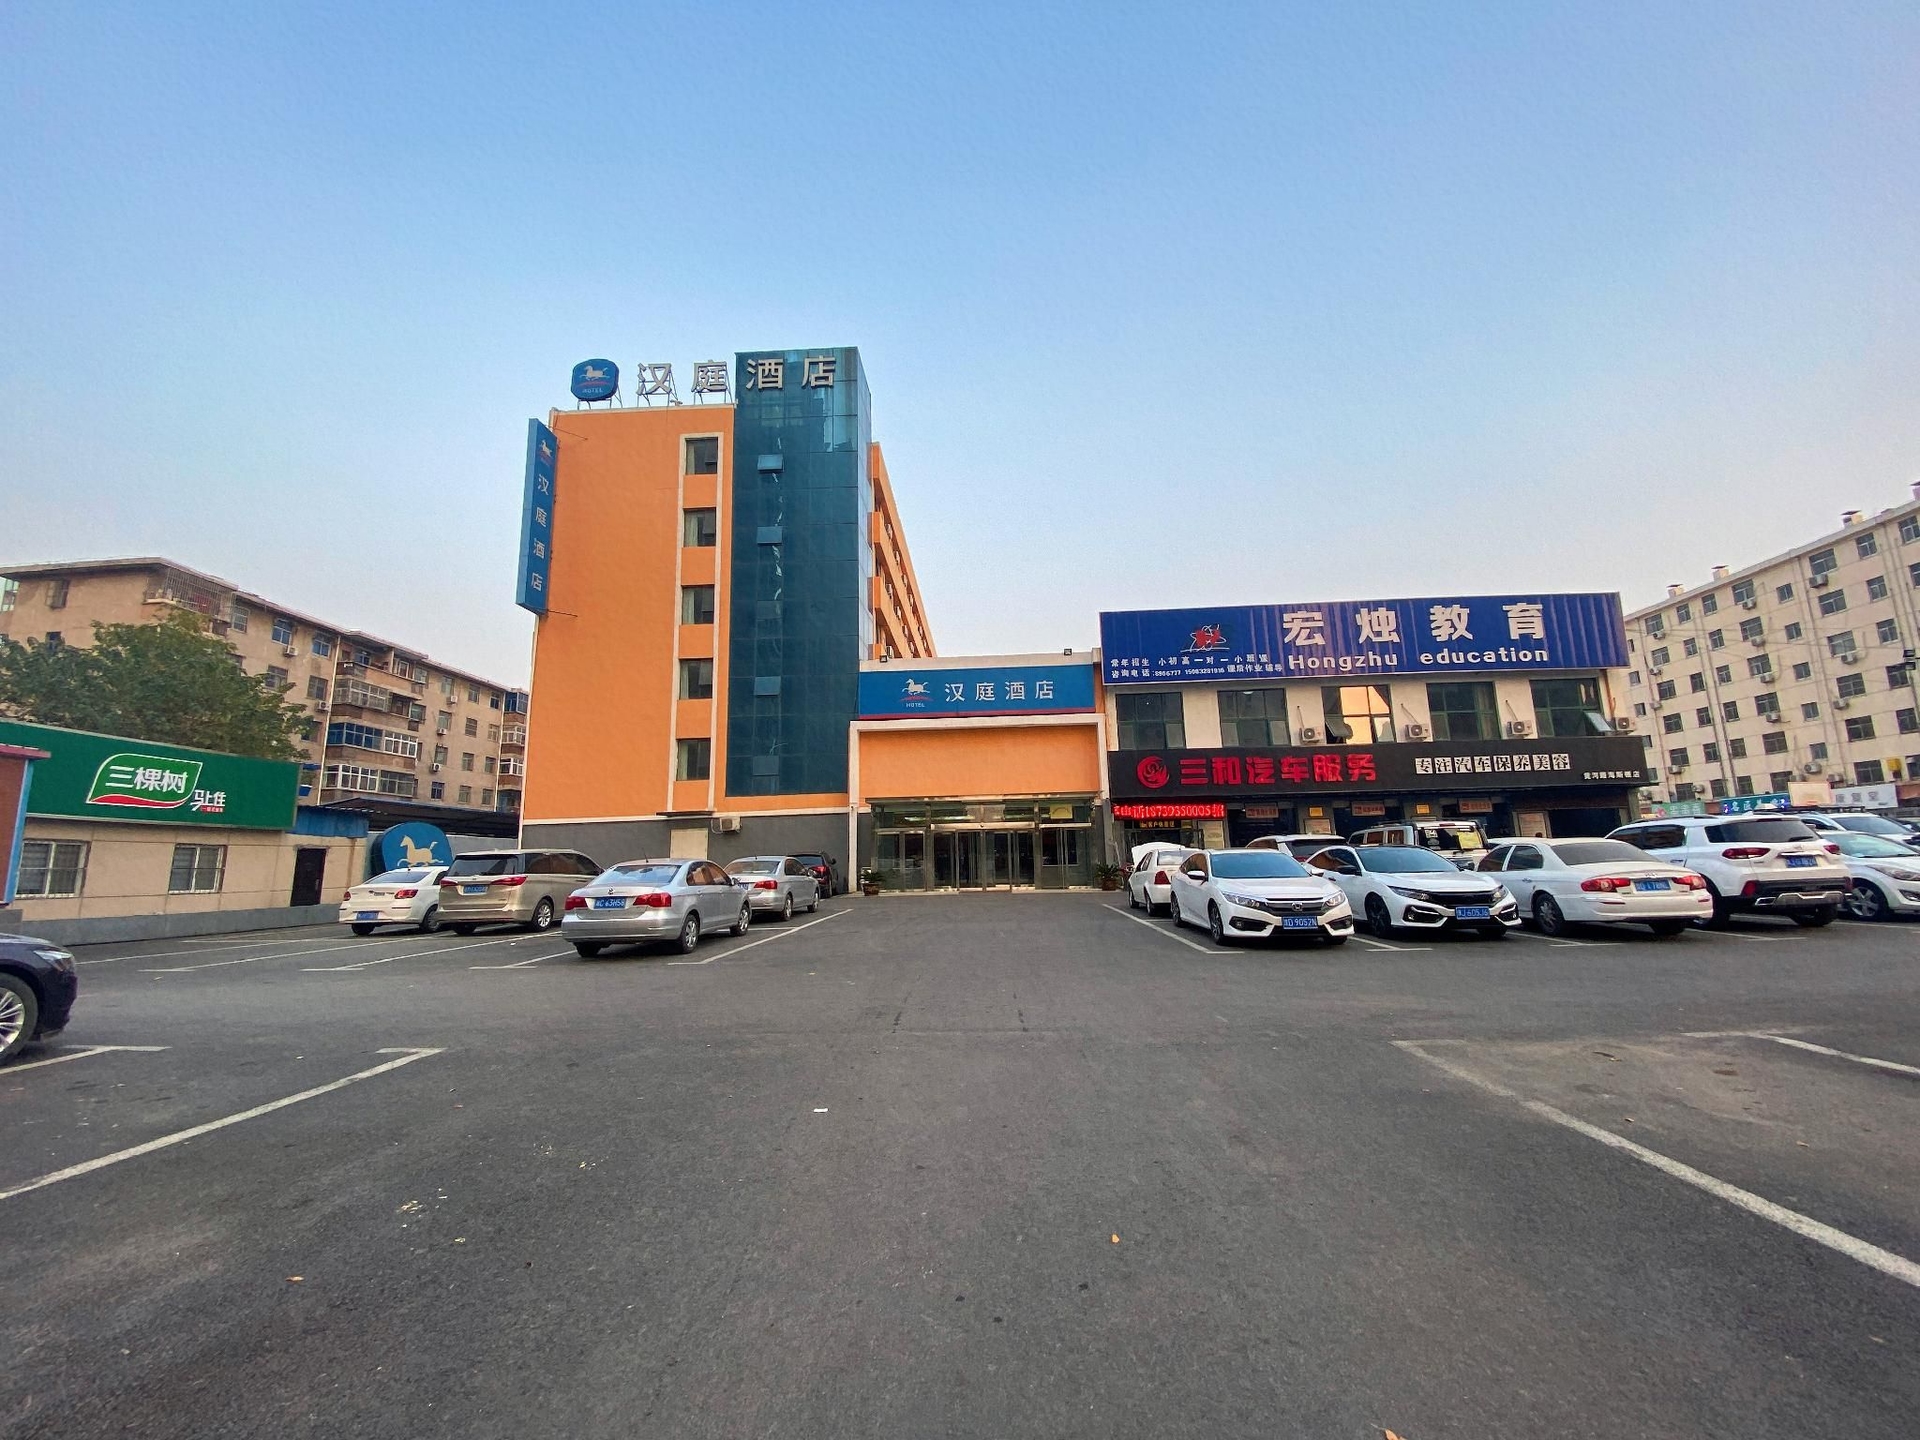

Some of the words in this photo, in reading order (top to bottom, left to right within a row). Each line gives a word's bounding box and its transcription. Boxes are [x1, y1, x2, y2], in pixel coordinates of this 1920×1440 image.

[637, 355, 837, 396] 汉庭酒店
[531, 473, 550, 593] 汉庭酒店
[1282, 602, 1545, 646] 宏烛教育
[1110, 657, 1150, 667] 常年招生
[1288, 651, 1398, 672] Hongzhu
[1419, 647, 1549, 665] education
[944, 680, 1054, 702] 汉庭酒店
[1179, 753, 1377, 786] 三和汽车服务
[1415, 754, 1570, 774] 专注汽车保养美容
[105, 766, 188, 793] 三棵树
